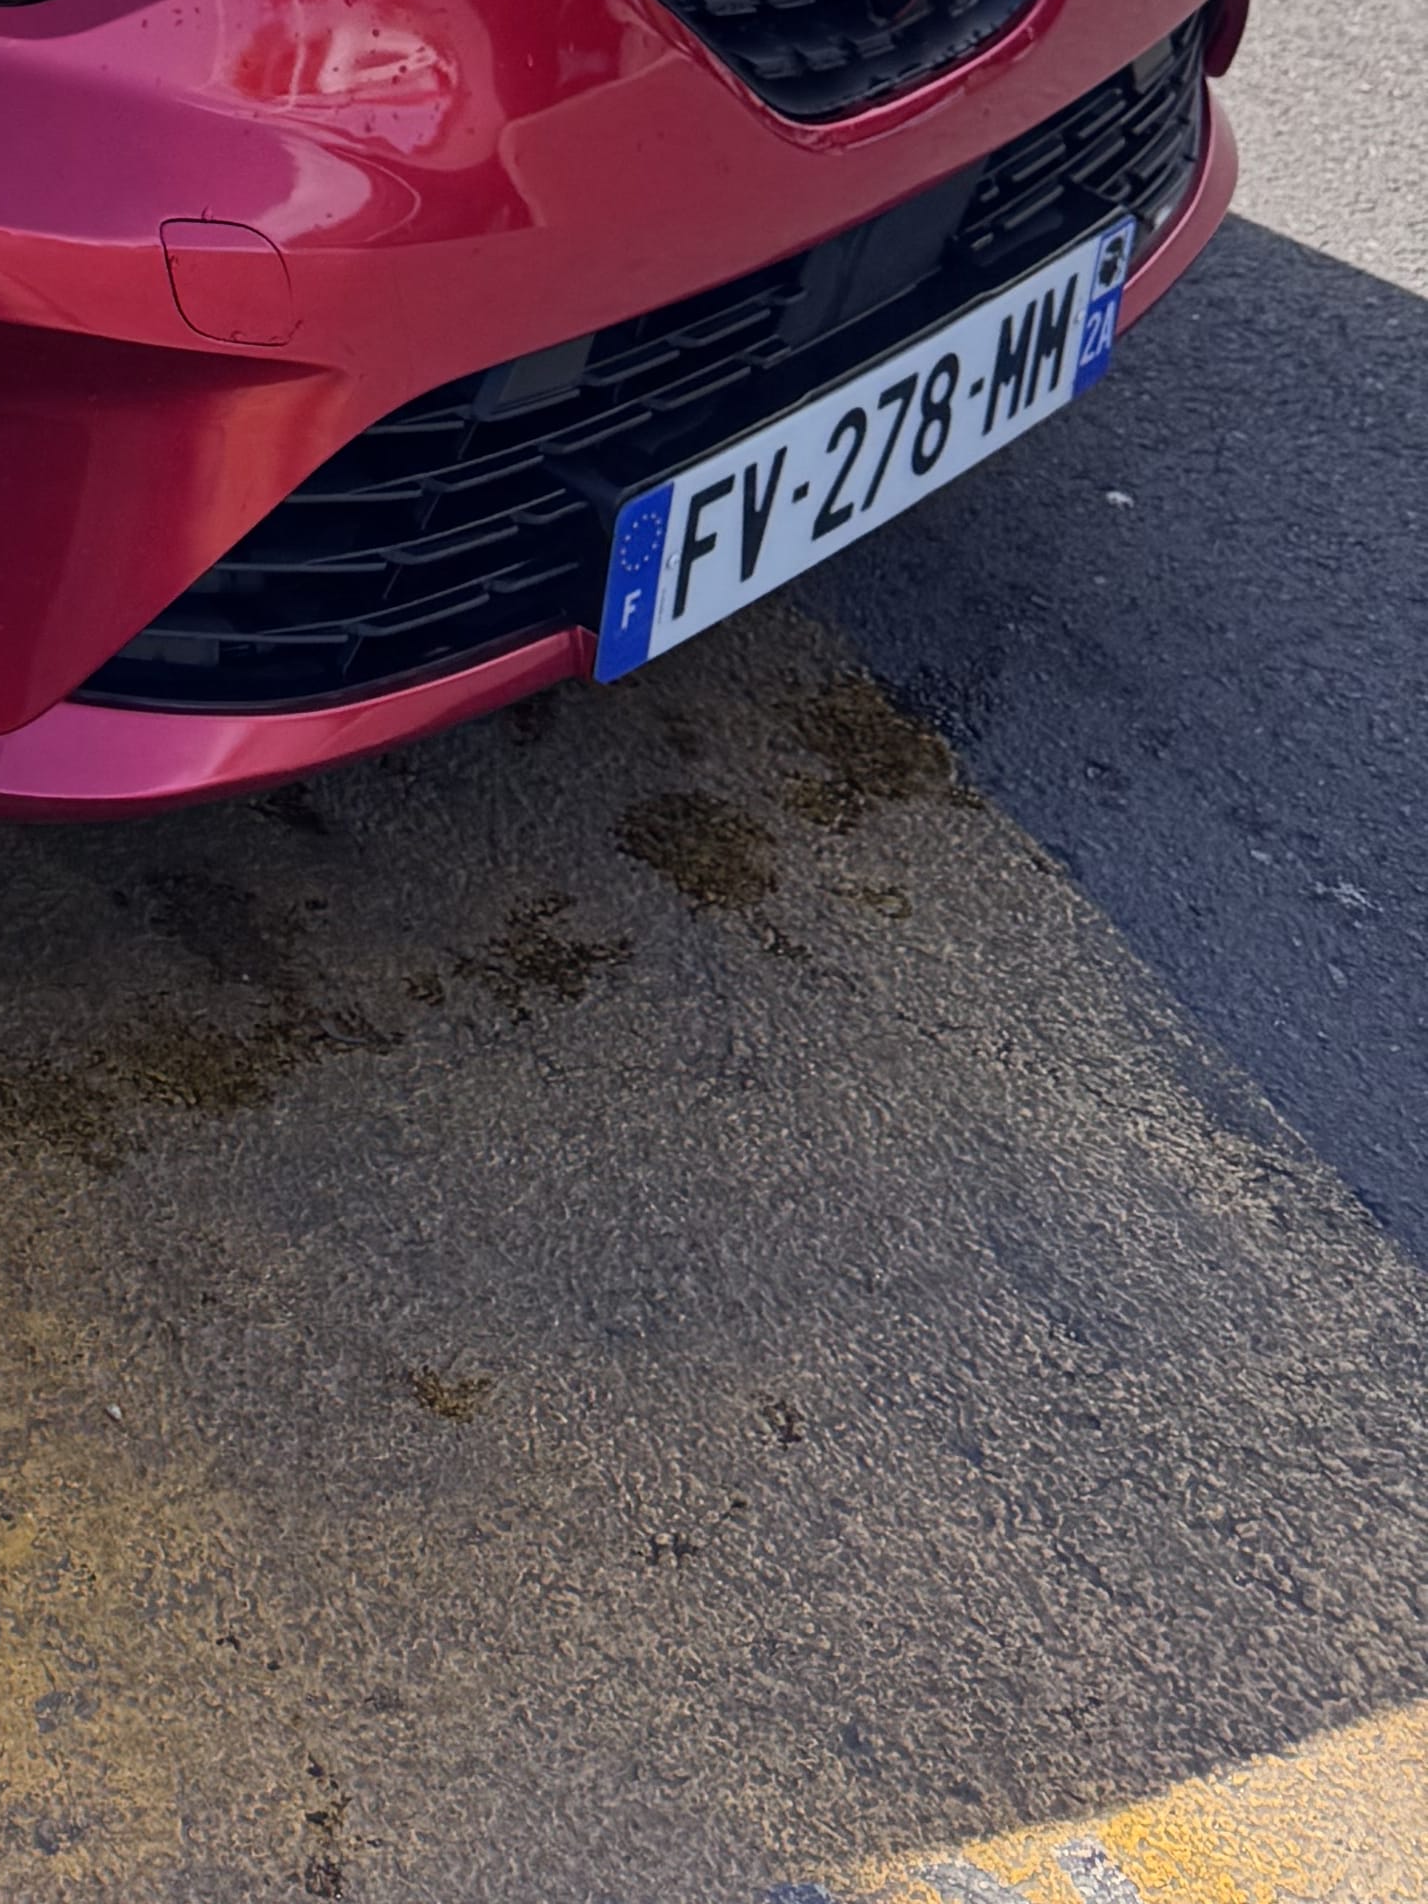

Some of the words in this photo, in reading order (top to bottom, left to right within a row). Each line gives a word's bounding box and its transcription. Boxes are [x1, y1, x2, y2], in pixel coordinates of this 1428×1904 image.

[1079, 300, 1116, 367] 2A
[672, 272, 1078, 620] FV-278-MM
[621, 589, 642, 630] F
